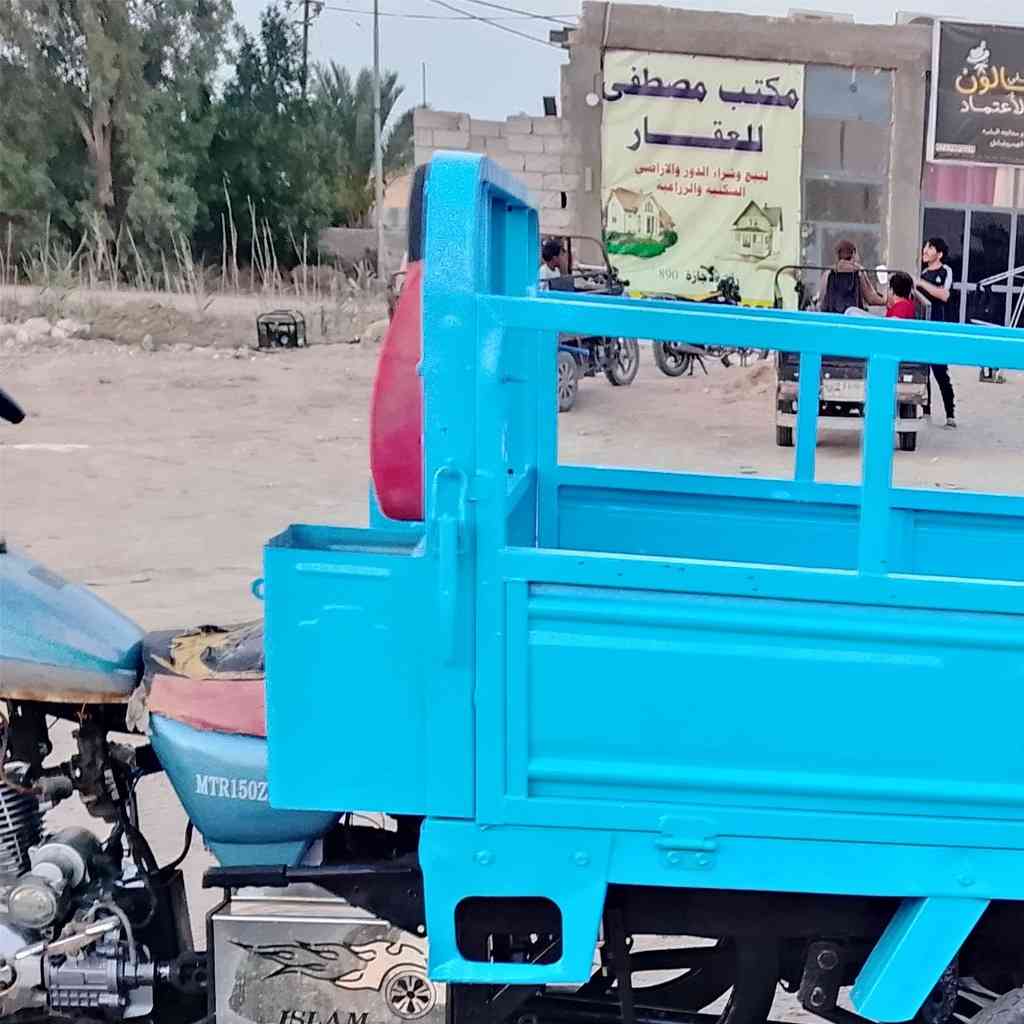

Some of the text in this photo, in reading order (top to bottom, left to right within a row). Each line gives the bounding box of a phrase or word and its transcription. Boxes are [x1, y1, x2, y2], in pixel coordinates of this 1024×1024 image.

[602, 67, 799, 110] مكتب مصطفى
[625, 116, 763, 152] للعقار
